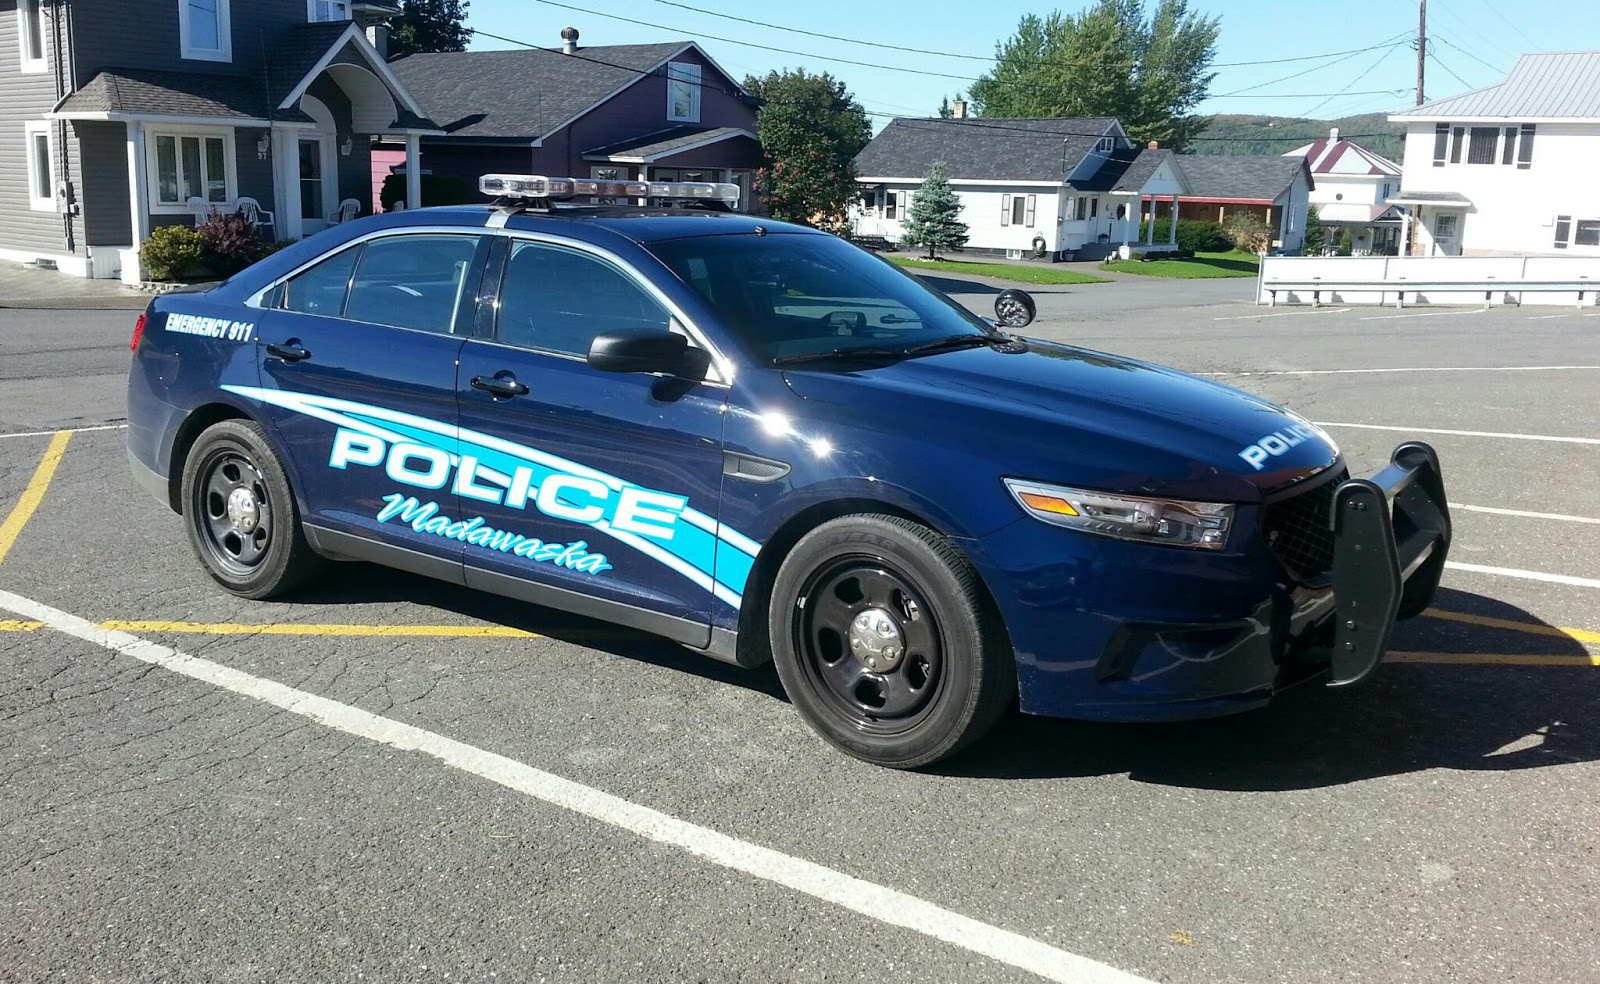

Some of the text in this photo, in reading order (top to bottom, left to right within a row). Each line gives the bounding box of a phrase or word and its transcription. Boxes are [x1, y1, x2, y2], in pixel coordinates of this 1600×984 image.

[165, 313, 254, 342] EMERGENCY 911
[1238, 424, 1316, 471] POLIC
[329, 427, 689, 540] POLICE
[376, 493, 613, 575] Madawaska
